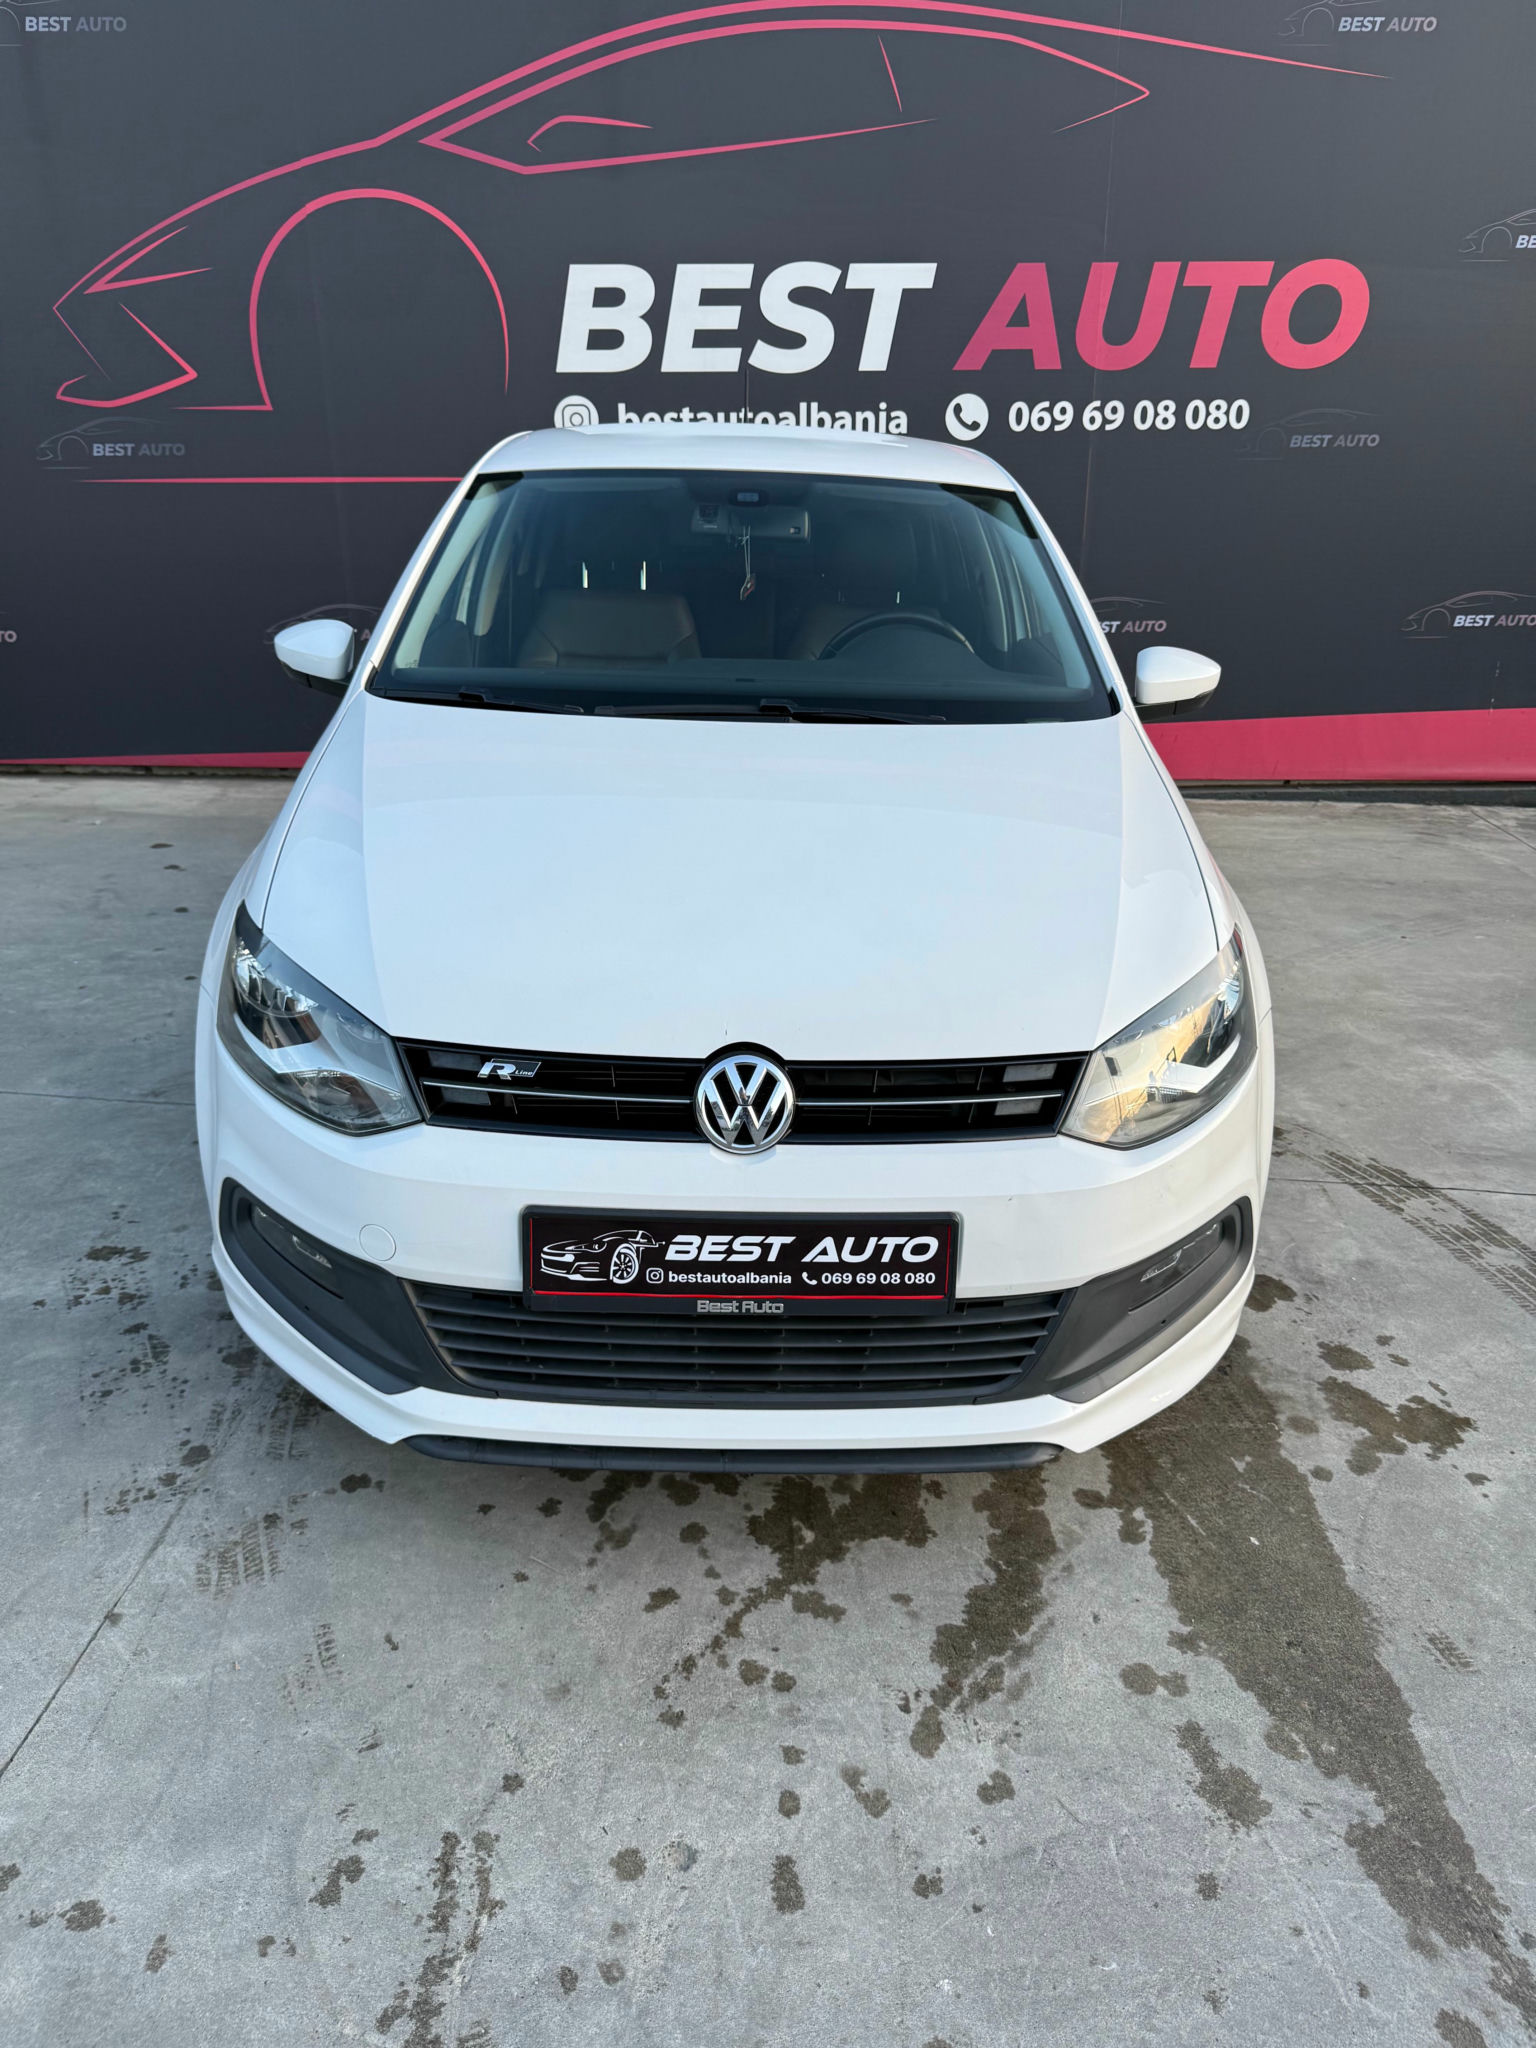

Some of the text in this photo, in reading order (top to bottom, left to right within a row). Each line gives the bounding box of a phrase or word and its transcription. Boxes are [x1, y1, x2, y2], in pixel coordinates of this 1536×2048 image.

[25, 16, 127, 32] BEST AUTO
[1338, 16, 1438, 32] BEST AUTO
[555, 258, 1370, 374] BEST AUTO
[1008, 399, 1250, 432] 069 69 08 080
[1289, 433, 1380, 448] BEST AUTO
[92, 443, 186, 457] BEST AUTO
[1121, 620, 1168, 633] AUTO
[1453, 615, 1495, 627] BEST
[477, 1061, 517, 1080] R
[664, 1234, 939, 1263] BEST AUTO
[668, 1270, 792, 1284] bestautoalbania
[821, 1272, 936, 1285] 069 69 08 080
[696, 1299, 785, 1314] Best Auto
